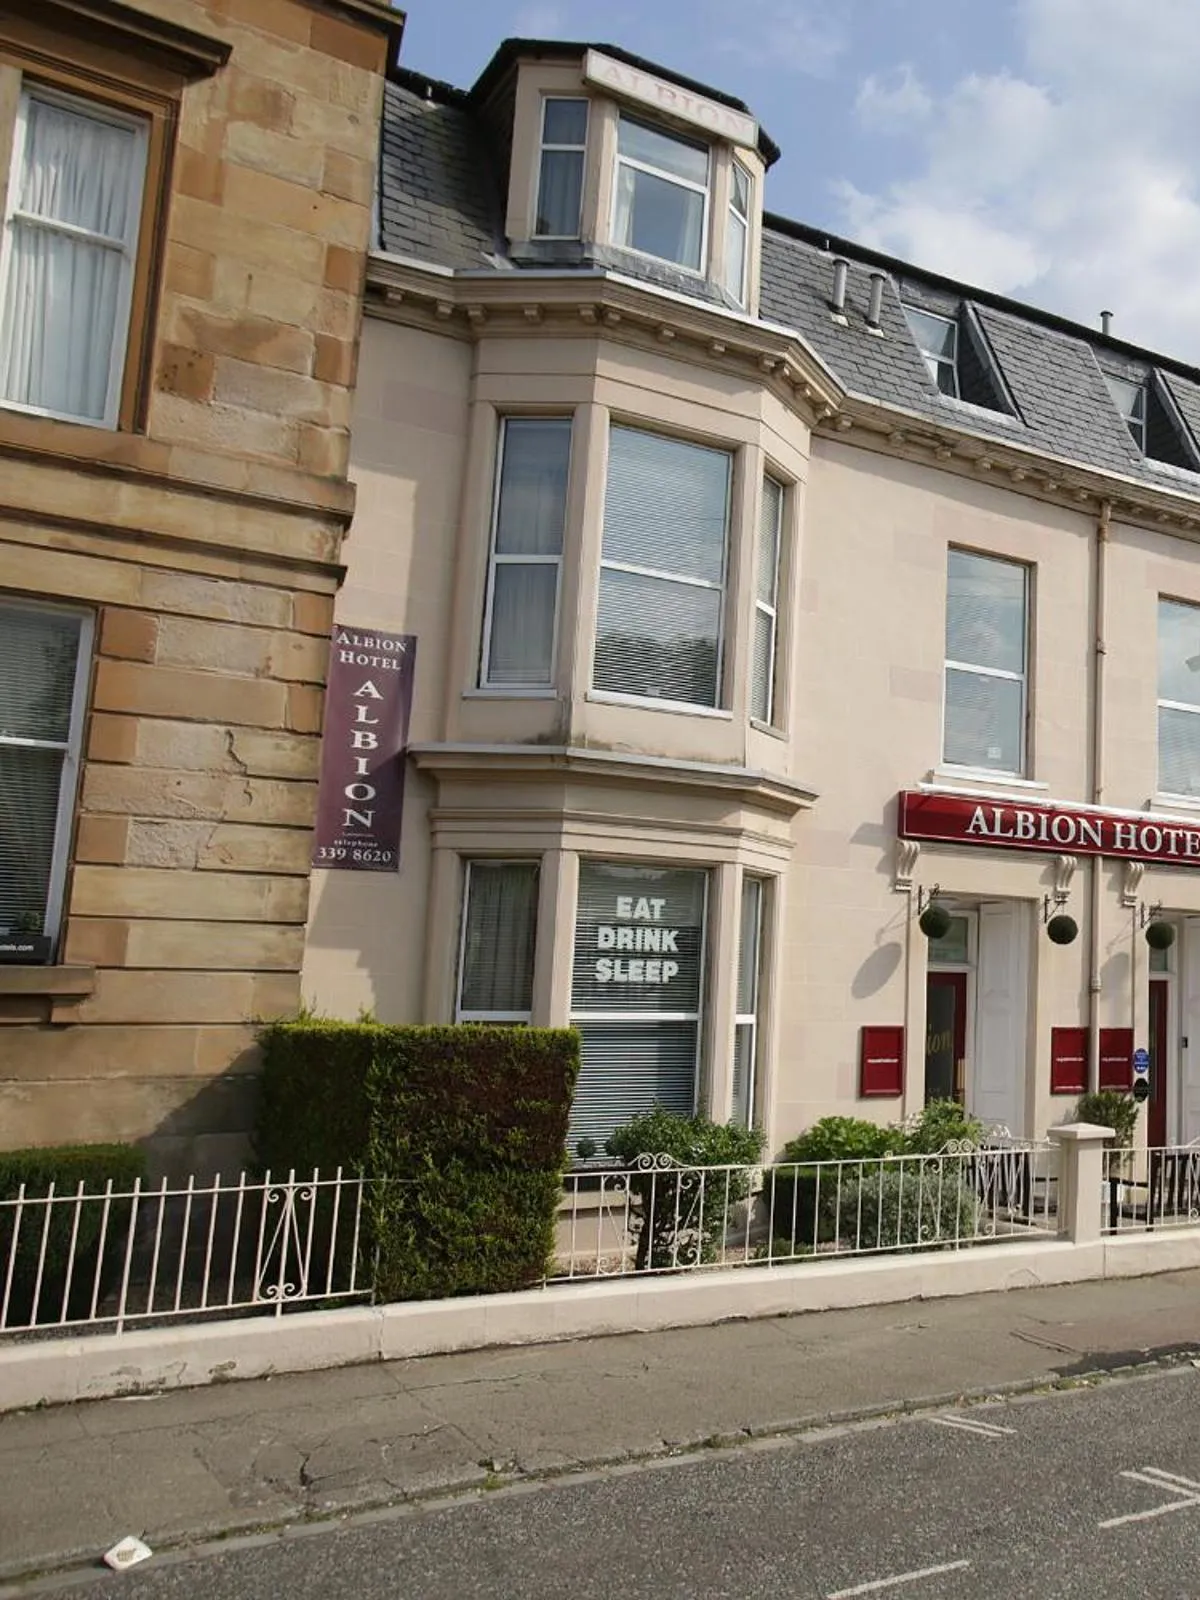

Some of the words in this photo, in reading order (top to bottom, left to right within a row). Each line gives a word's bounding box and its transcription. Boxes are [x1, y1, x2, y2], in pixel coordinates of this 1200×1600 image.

[336, 631, 407, 653] ALBION
[339, 650, 401, 670] HOTEL
[342, 680, 384, 829] ALBION
[966, 805, 1102, 847] ALBION
[317, 846, 347, 861] 339
[352, 848, 392, 864] 8620
[616, 896, 666, 919] EAT
[598, 927, 679, 951] DRINK
[595, 957, 679, 983] SLEEP
